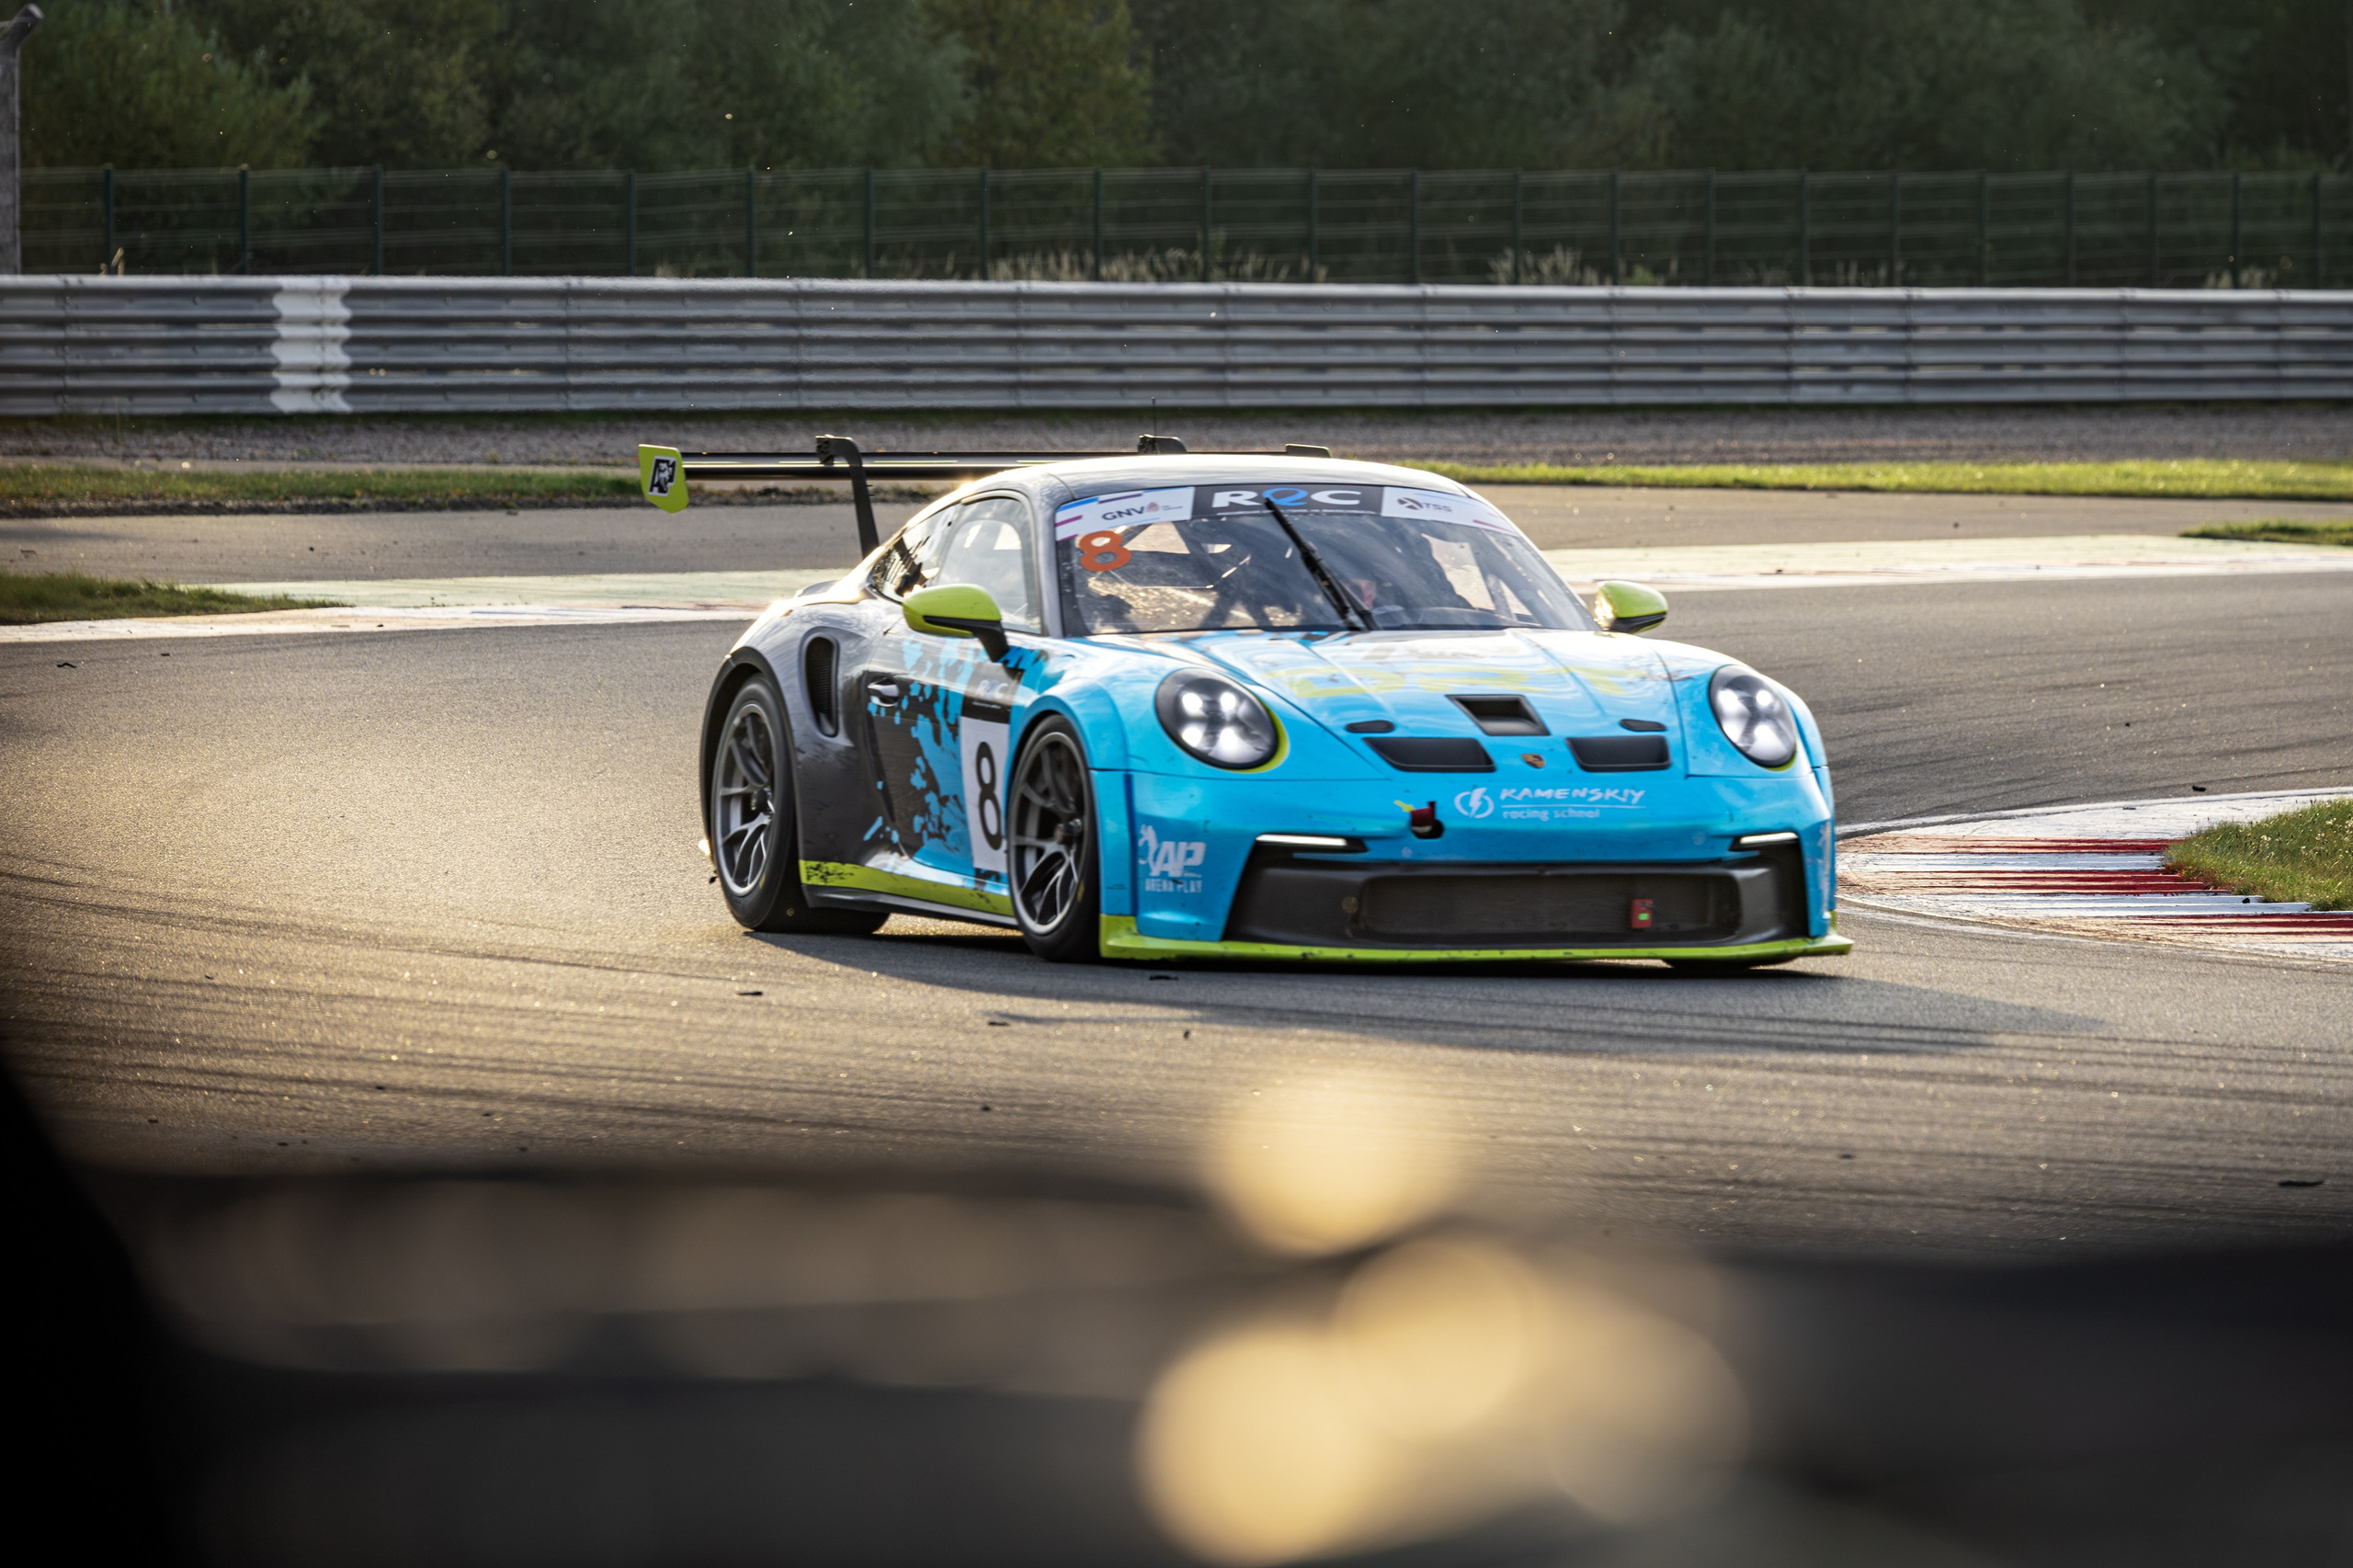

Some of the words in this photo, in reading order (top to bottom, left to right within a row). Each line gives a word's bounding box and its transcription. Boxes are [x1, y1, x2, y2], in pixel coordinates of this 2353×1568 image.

[1101, 506, 1145, 521] GNV
[1078, 529, 1132, 573] 8
[975, 741, 1003, 851] 8
[1499, 787, 1646, 805] KAMENSKIY
[1502, 808, 1550, 822] racing
[1552, 808, 1600, 819] school
